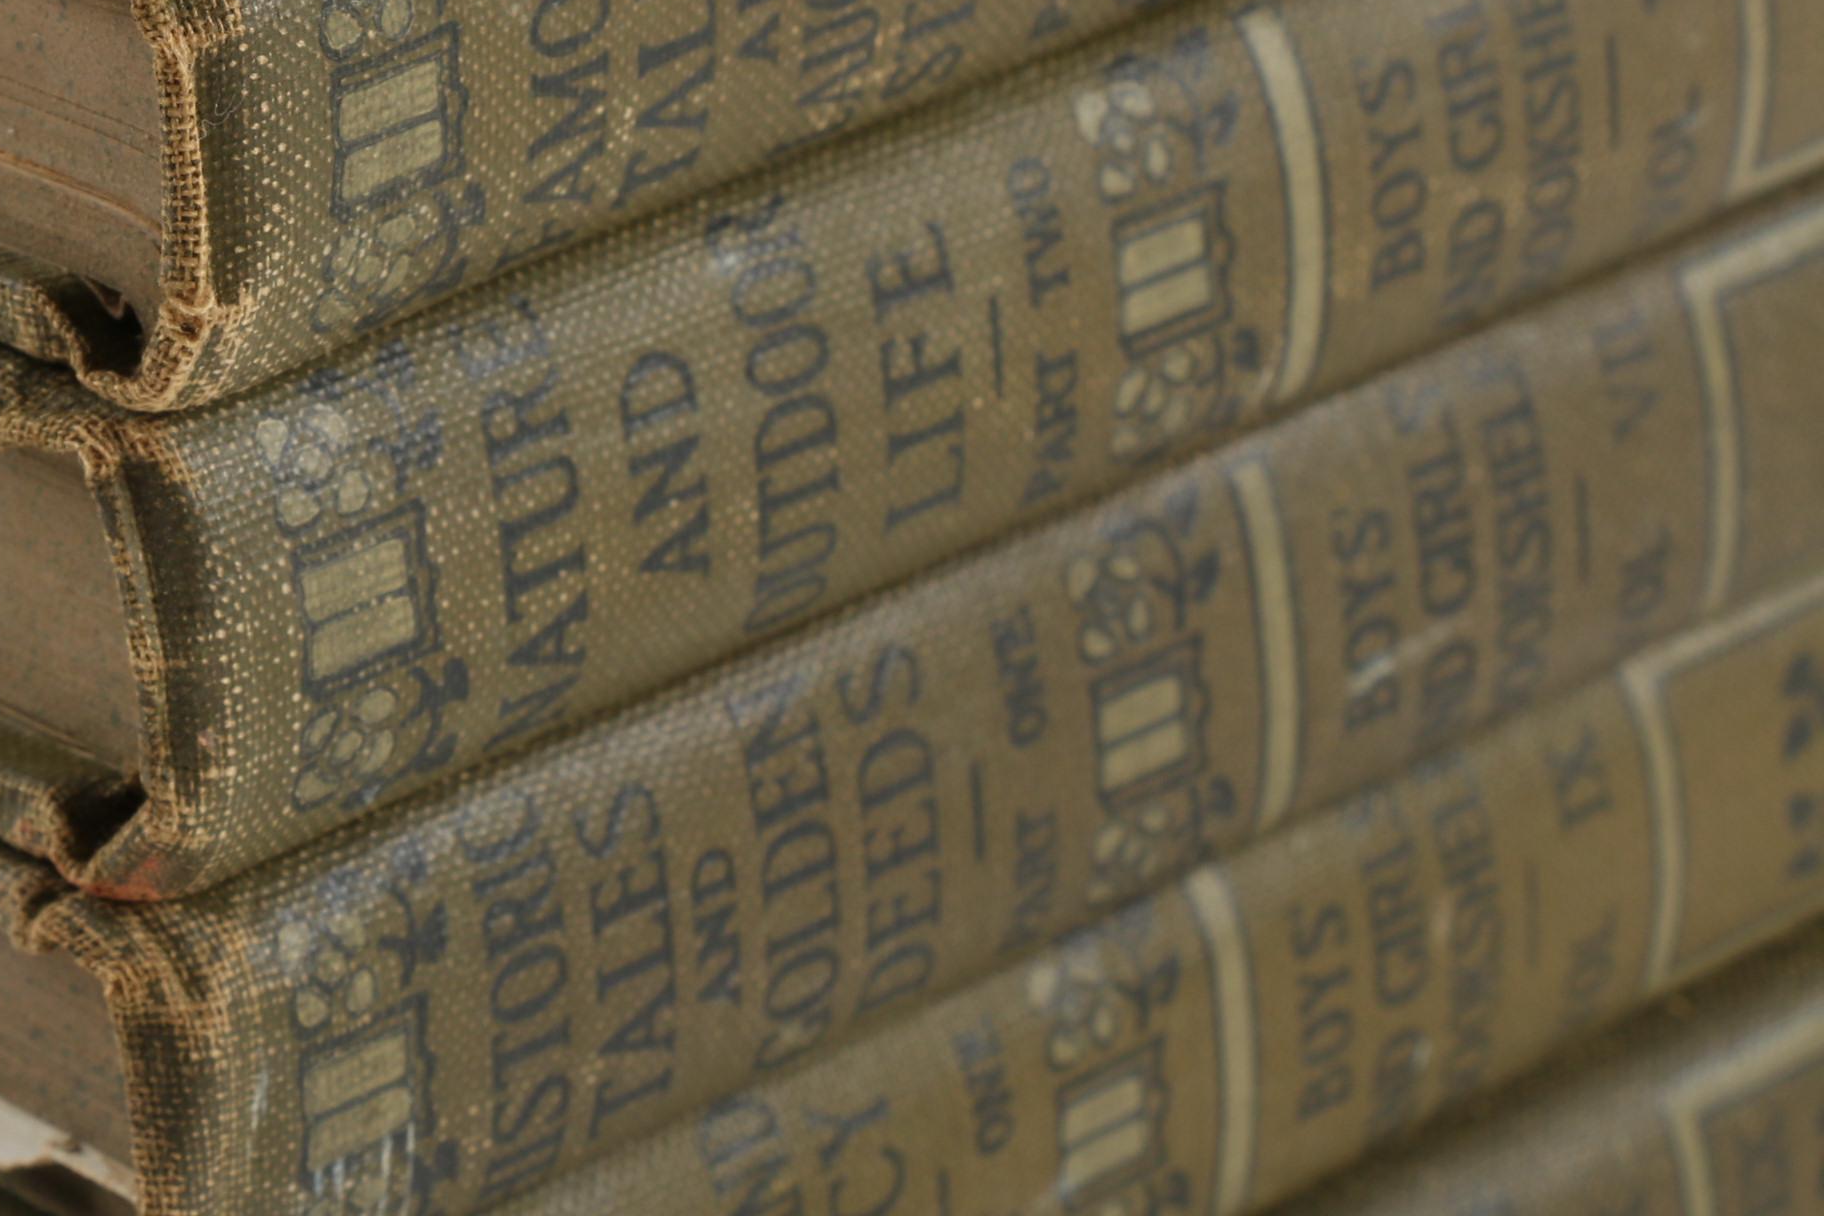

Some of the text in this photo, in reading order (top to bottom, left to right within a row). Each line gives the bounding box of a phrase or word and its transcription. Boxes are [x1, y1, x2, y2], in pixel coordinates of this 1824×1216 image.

[616, 346, 711, 578] AND
[865, 219, 966, 534] LIFE
[1006, 157, 1077, 508] PART TWO
[835, 644, 943, 1015] DEEDS
[991, 604, 1048, 748] ONE
[570, 781, 675, 1142] TALES
[689, 847, 742, 1006] AND
[725, 678, 842, 1072] GOLDEN
